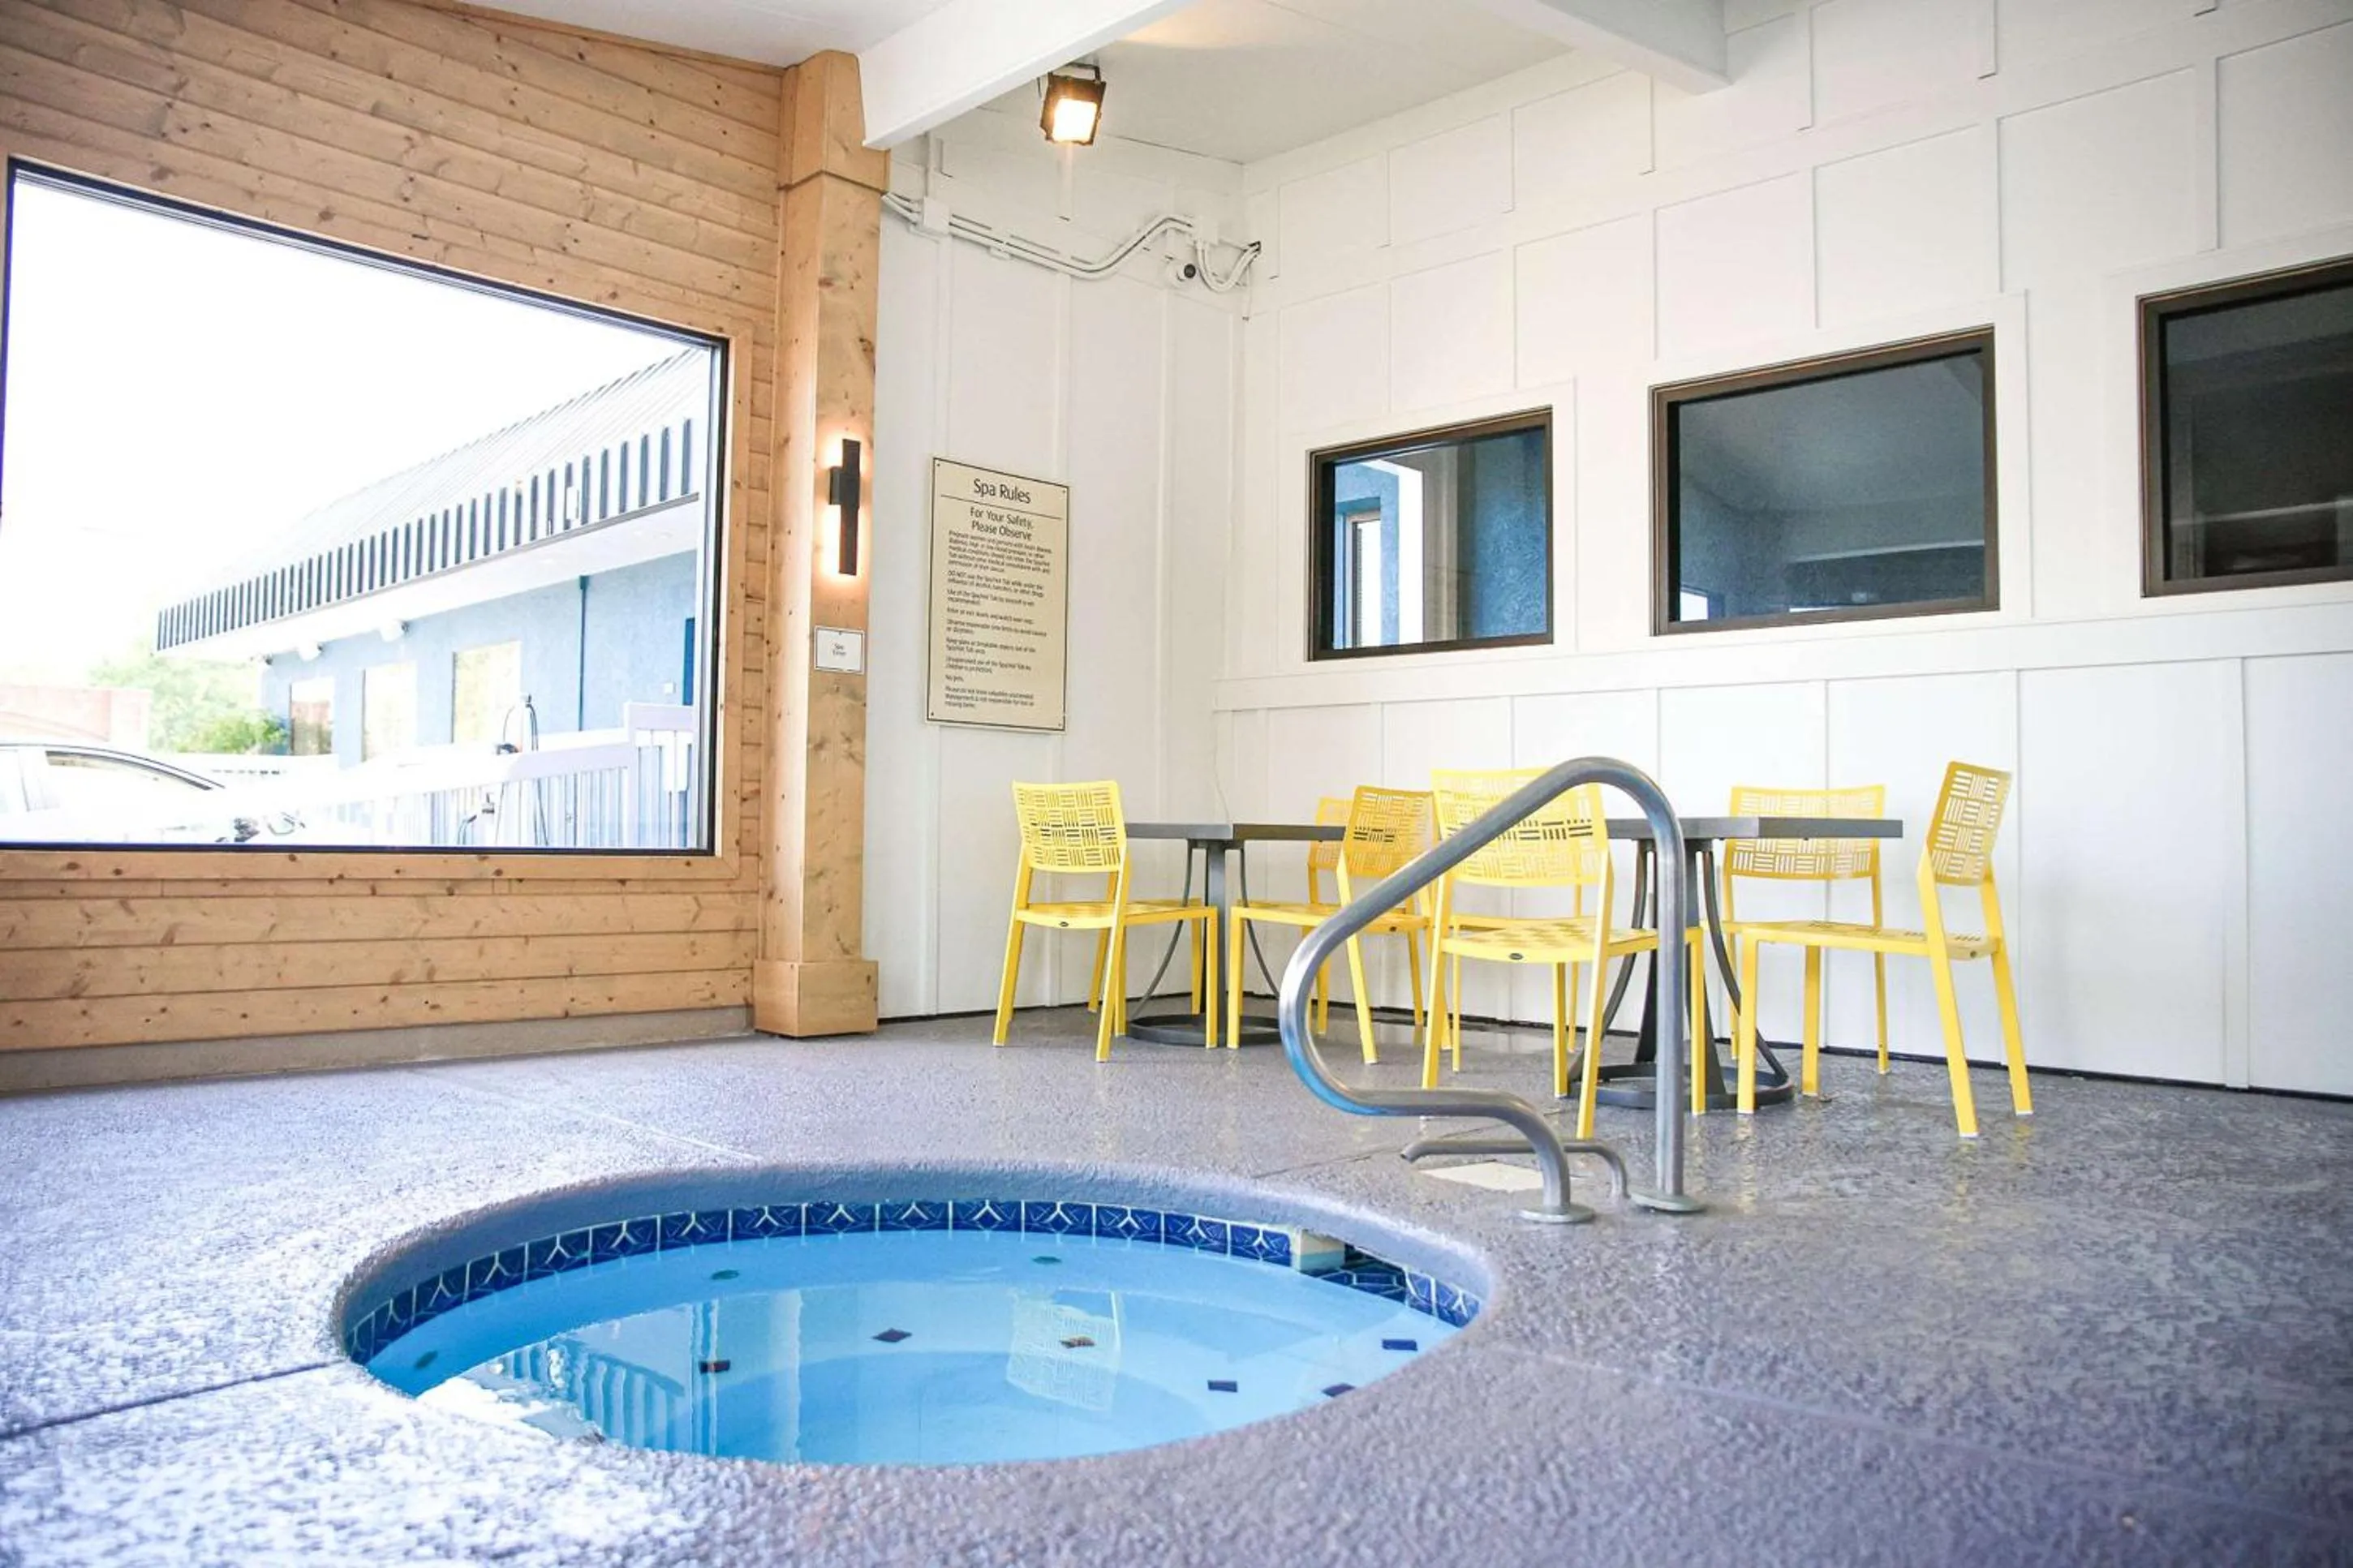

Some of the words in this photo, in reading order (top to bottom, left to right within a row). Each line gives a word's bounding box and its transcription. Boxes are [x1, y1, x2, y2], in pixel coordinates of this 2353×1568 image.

[974, 478, 996, 497] Spa
[1000, 483, 1031, 504] Rules
[970, 507, 983, 518] For
[986, 510, 1004, 522] Your
[972, 520, 997, 533] Please
[999, 525, 1032, 541] Observe
